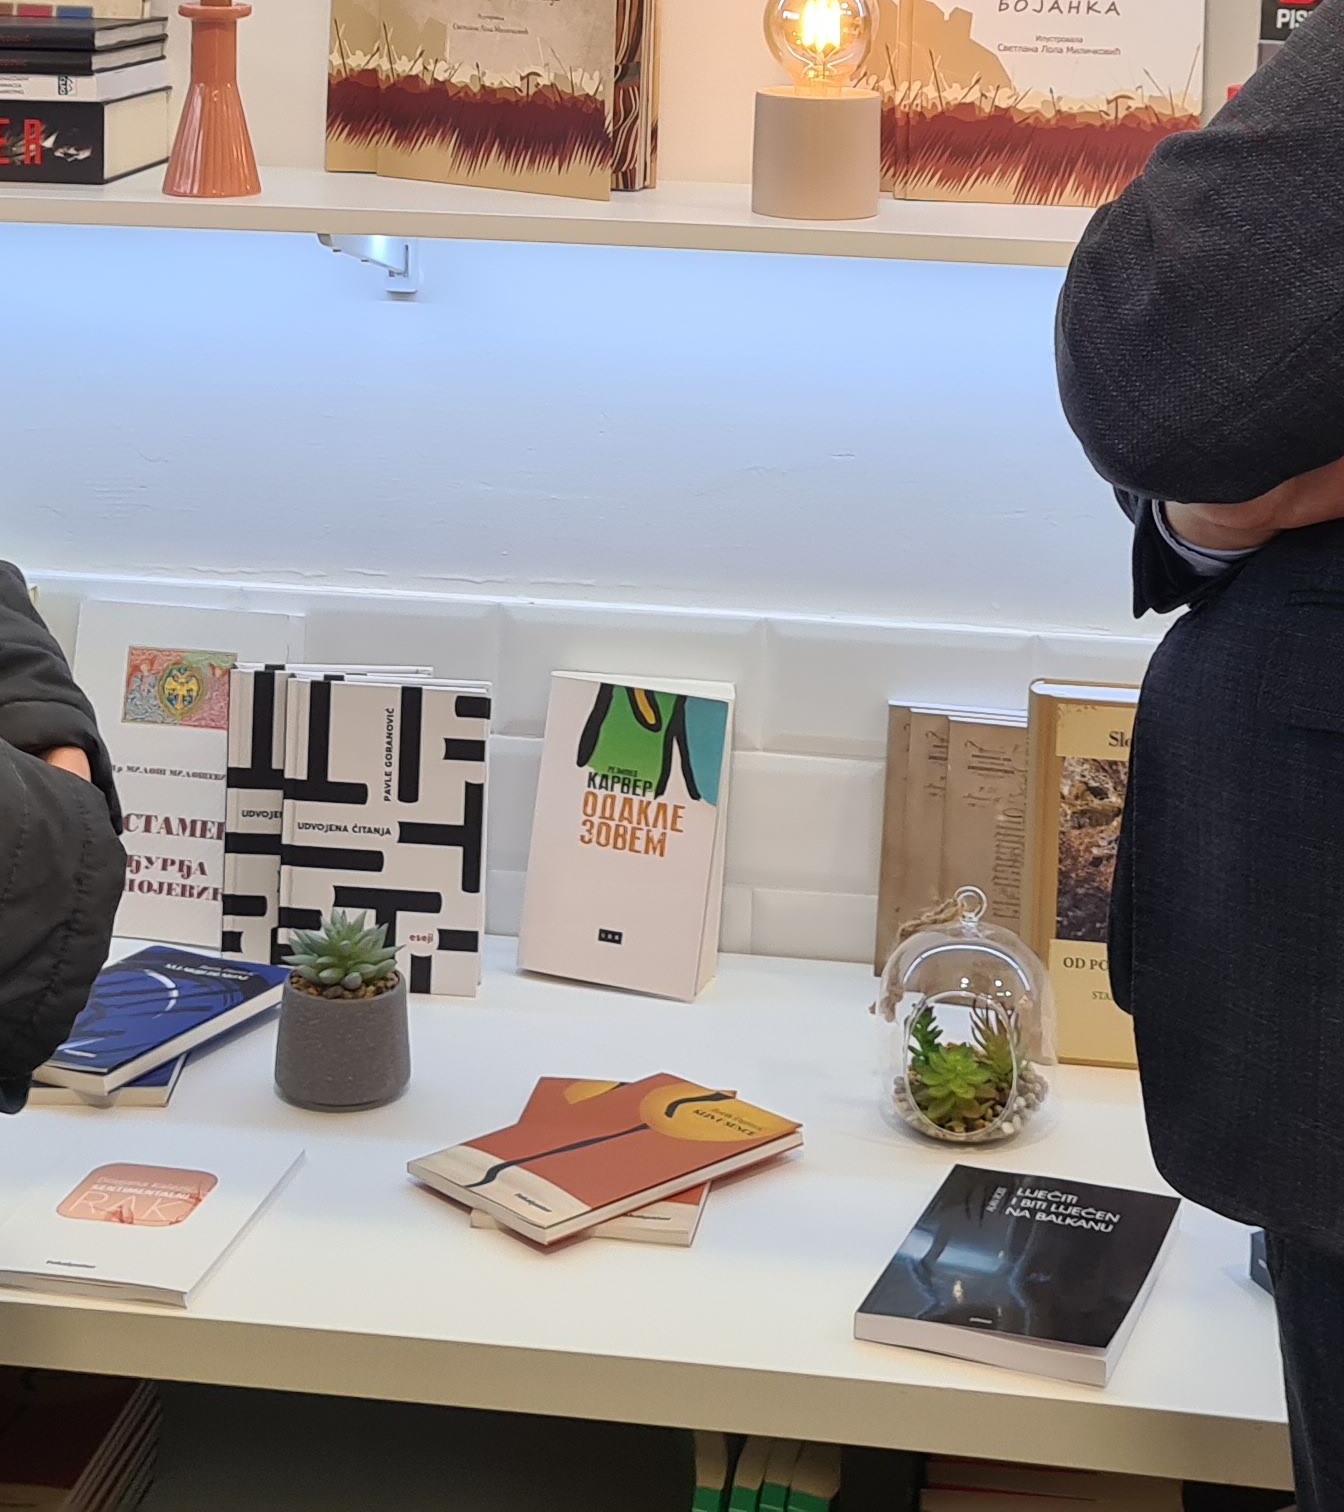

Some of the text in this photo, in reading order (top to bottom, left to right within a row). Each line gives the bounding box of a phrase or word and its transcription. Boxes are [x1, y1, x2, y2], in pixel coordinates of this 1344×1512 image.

[1276, 9, 1313, 29] PIS
[384, 707, 395, 802] PAVLE GORANOVIĆ
[587, 771, 654, 798] КАРВЕР
[582, 791, 686, 833] ОДАКЛЕ
[297, 822, 392, 836] UDVOJENA ČITANJA
[579, 818, 668, 858] ЗОВЕМ
[409, 933, 434, 944] eseji
[1063, 956, 1085, 969] OD
[68, 1190, 184, 1221] RAK
[1016, 1187, 1079, 1204] LIJEČITI
[1005, 1207, 1114, 1233] NA BALKANU
[1020, 1198, 1048, 1211] BITI
[1050, 1203, 1121, 1223] LIJEČEN
